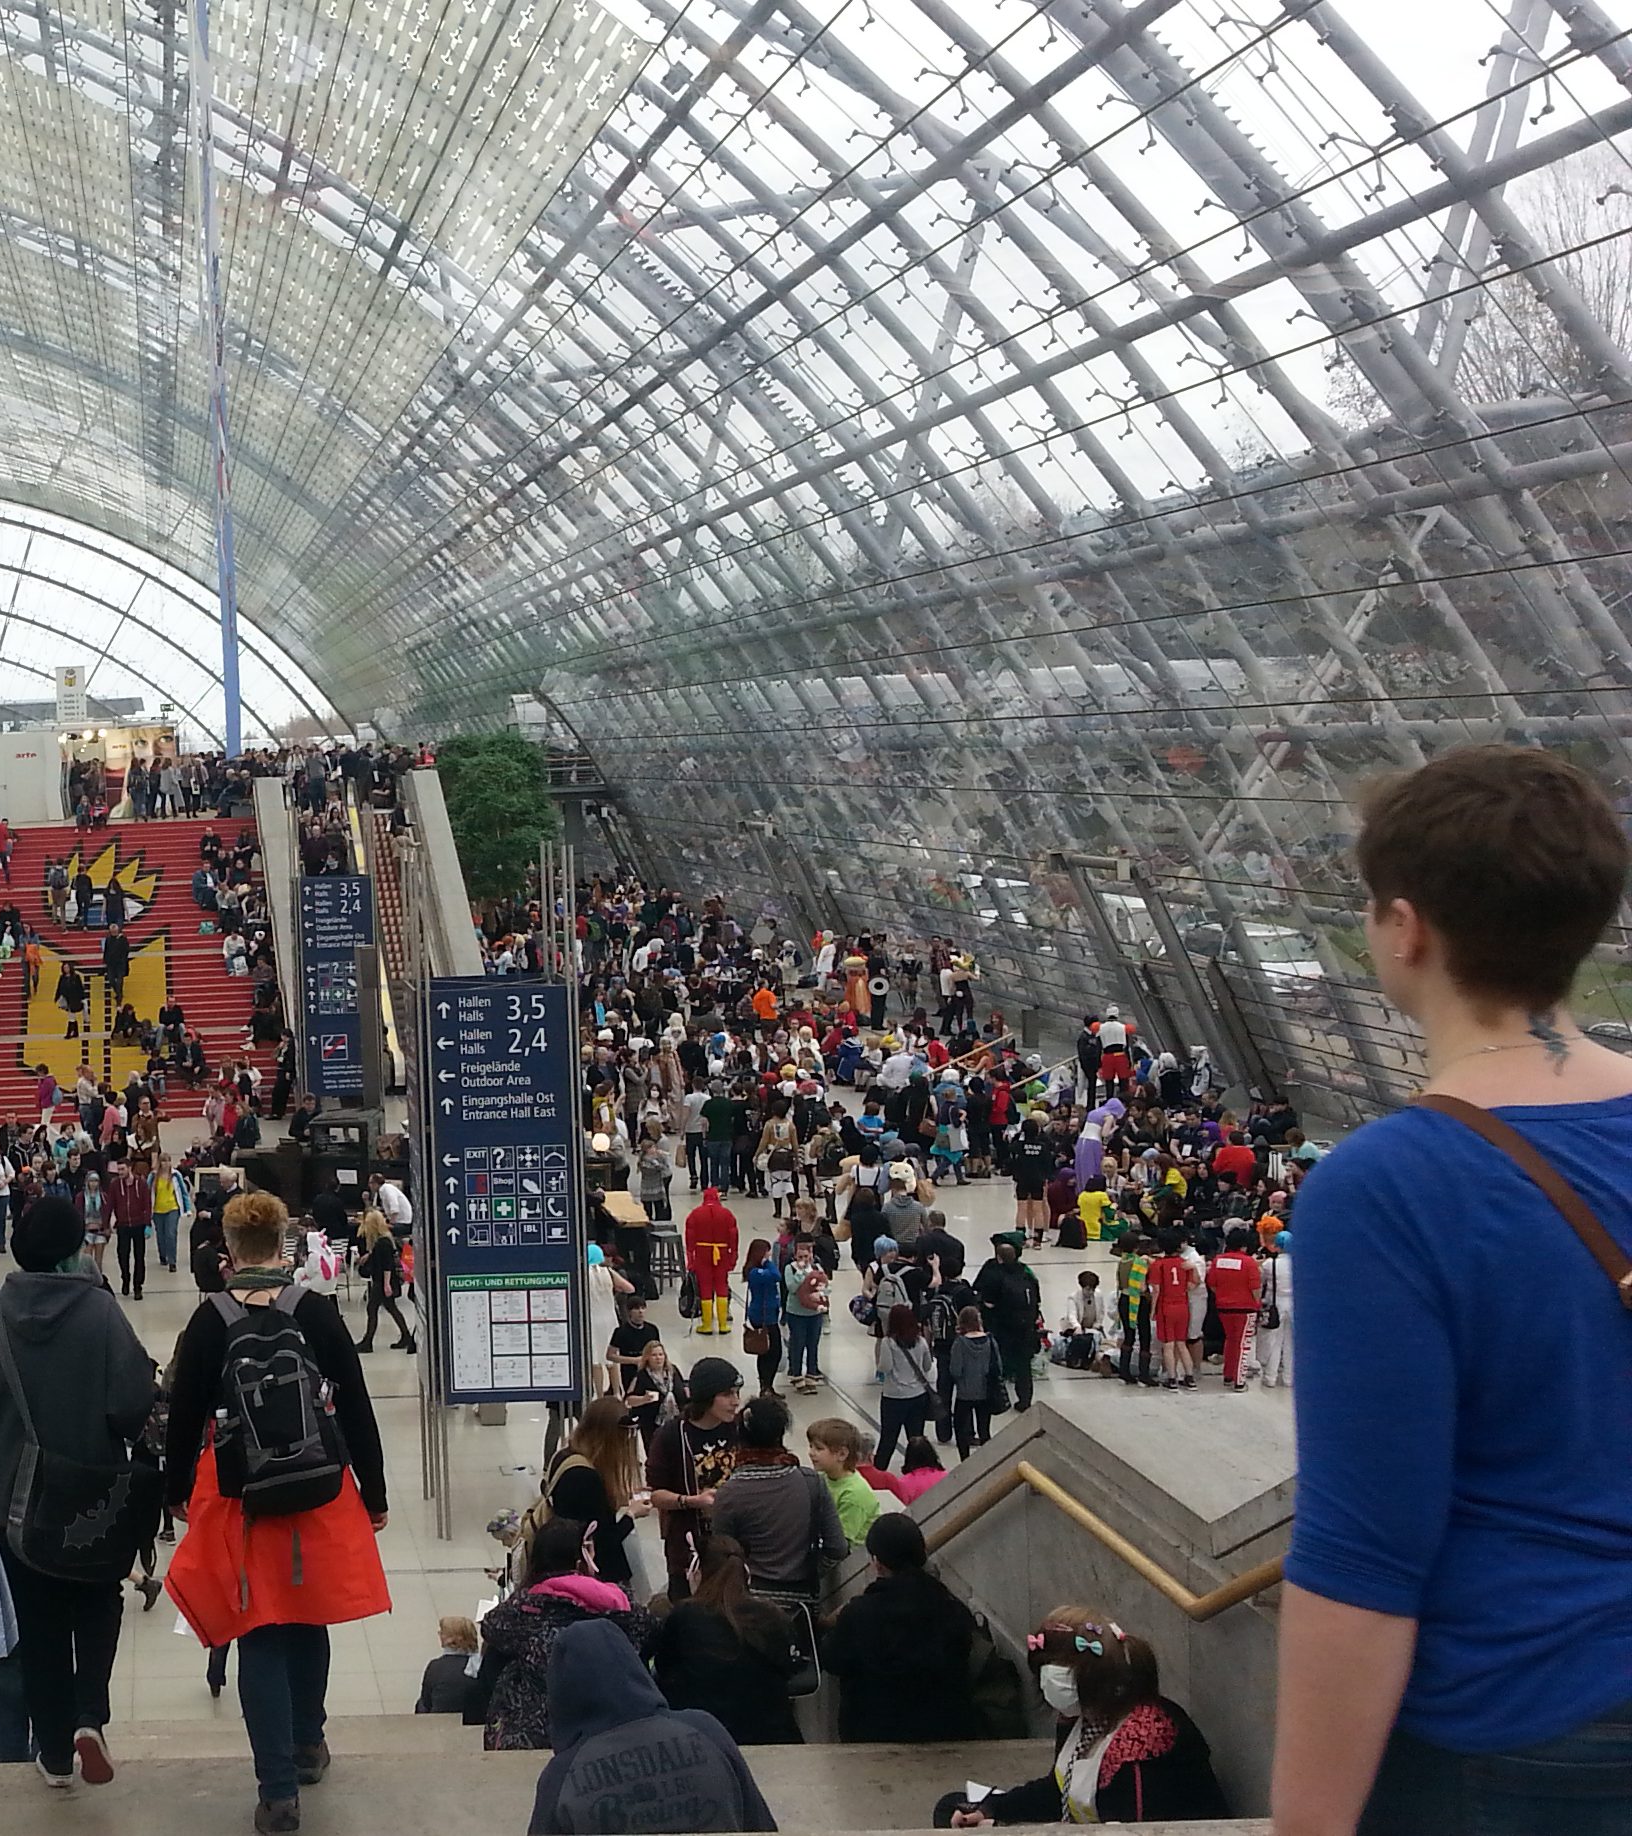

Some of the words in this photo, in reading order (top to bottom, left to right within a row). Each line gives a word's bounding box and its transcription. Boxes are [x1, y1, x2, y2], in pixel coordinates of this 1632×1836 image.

[15, 751, 38, 759] arte
[339, 882, 360, 897] 3,5
[340, 899, 361, 915] 2,4
[458, 996, 492, 1008] Hallen
[506, 994, 546, 1023] 3,5
[458, 1010, 484, 1022] Halls
[459, 1029, 493, 1041] Hallen
[508, 1027, 548, 1056] 2,4
[460, 1042, 486, 1055] Halls
[460, 1059, 521, 1076] Freigelände
[461, 1075, 504, 1087] Outdoor
[506, 1074, 532, 1086] Area
[462, 1092, 534, 1109] Eingangshalle
[536, 1092, 555, 1103] Ost
[462, 1109, 508, 1121] Entrance
[510, 1107, 531, 1119] Hall
[533, 1106, 557, 1118] East
[466, 1150, 487, 1159] EXIT
[493, 1177, 514, 1186] Shop
[450, 1279, 483, 1288] FLUCHT-
[484, 1278, 504, 1287] UND
[504, 1276, 568, 1286] RETTUNGSPLAN
[1170, 1266, 1179, 1285] 1
[569, 1732, 709, 1798] LONSDALE
